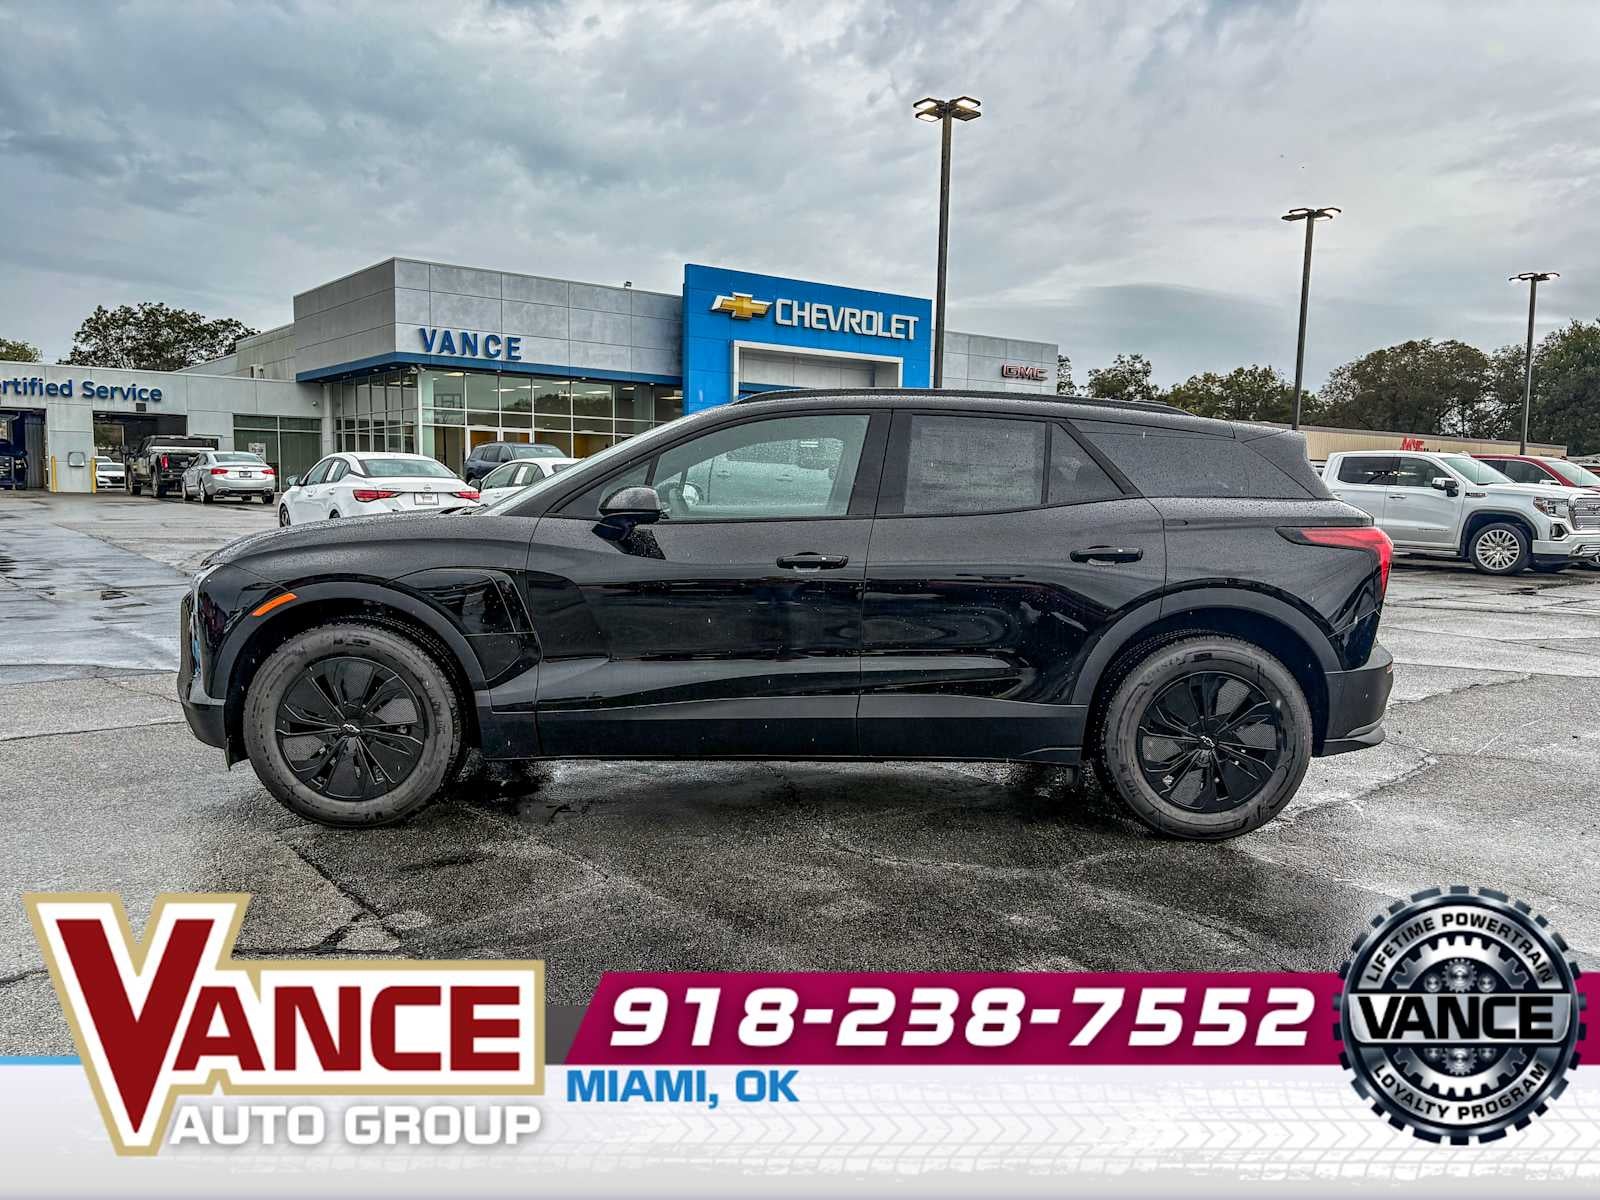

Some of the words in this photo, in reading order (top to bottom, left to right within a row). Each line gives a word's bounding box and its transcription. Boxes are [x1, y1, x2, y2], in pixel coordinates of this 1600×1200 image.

[775, 298, 919, 340] CHEVROLET
[419, 327, 522, 361] VANCE
[1001, 364, 1048, 381] GMC
[0, 377, 73, 398] rtified
[82, 381, 162, 401] Service
